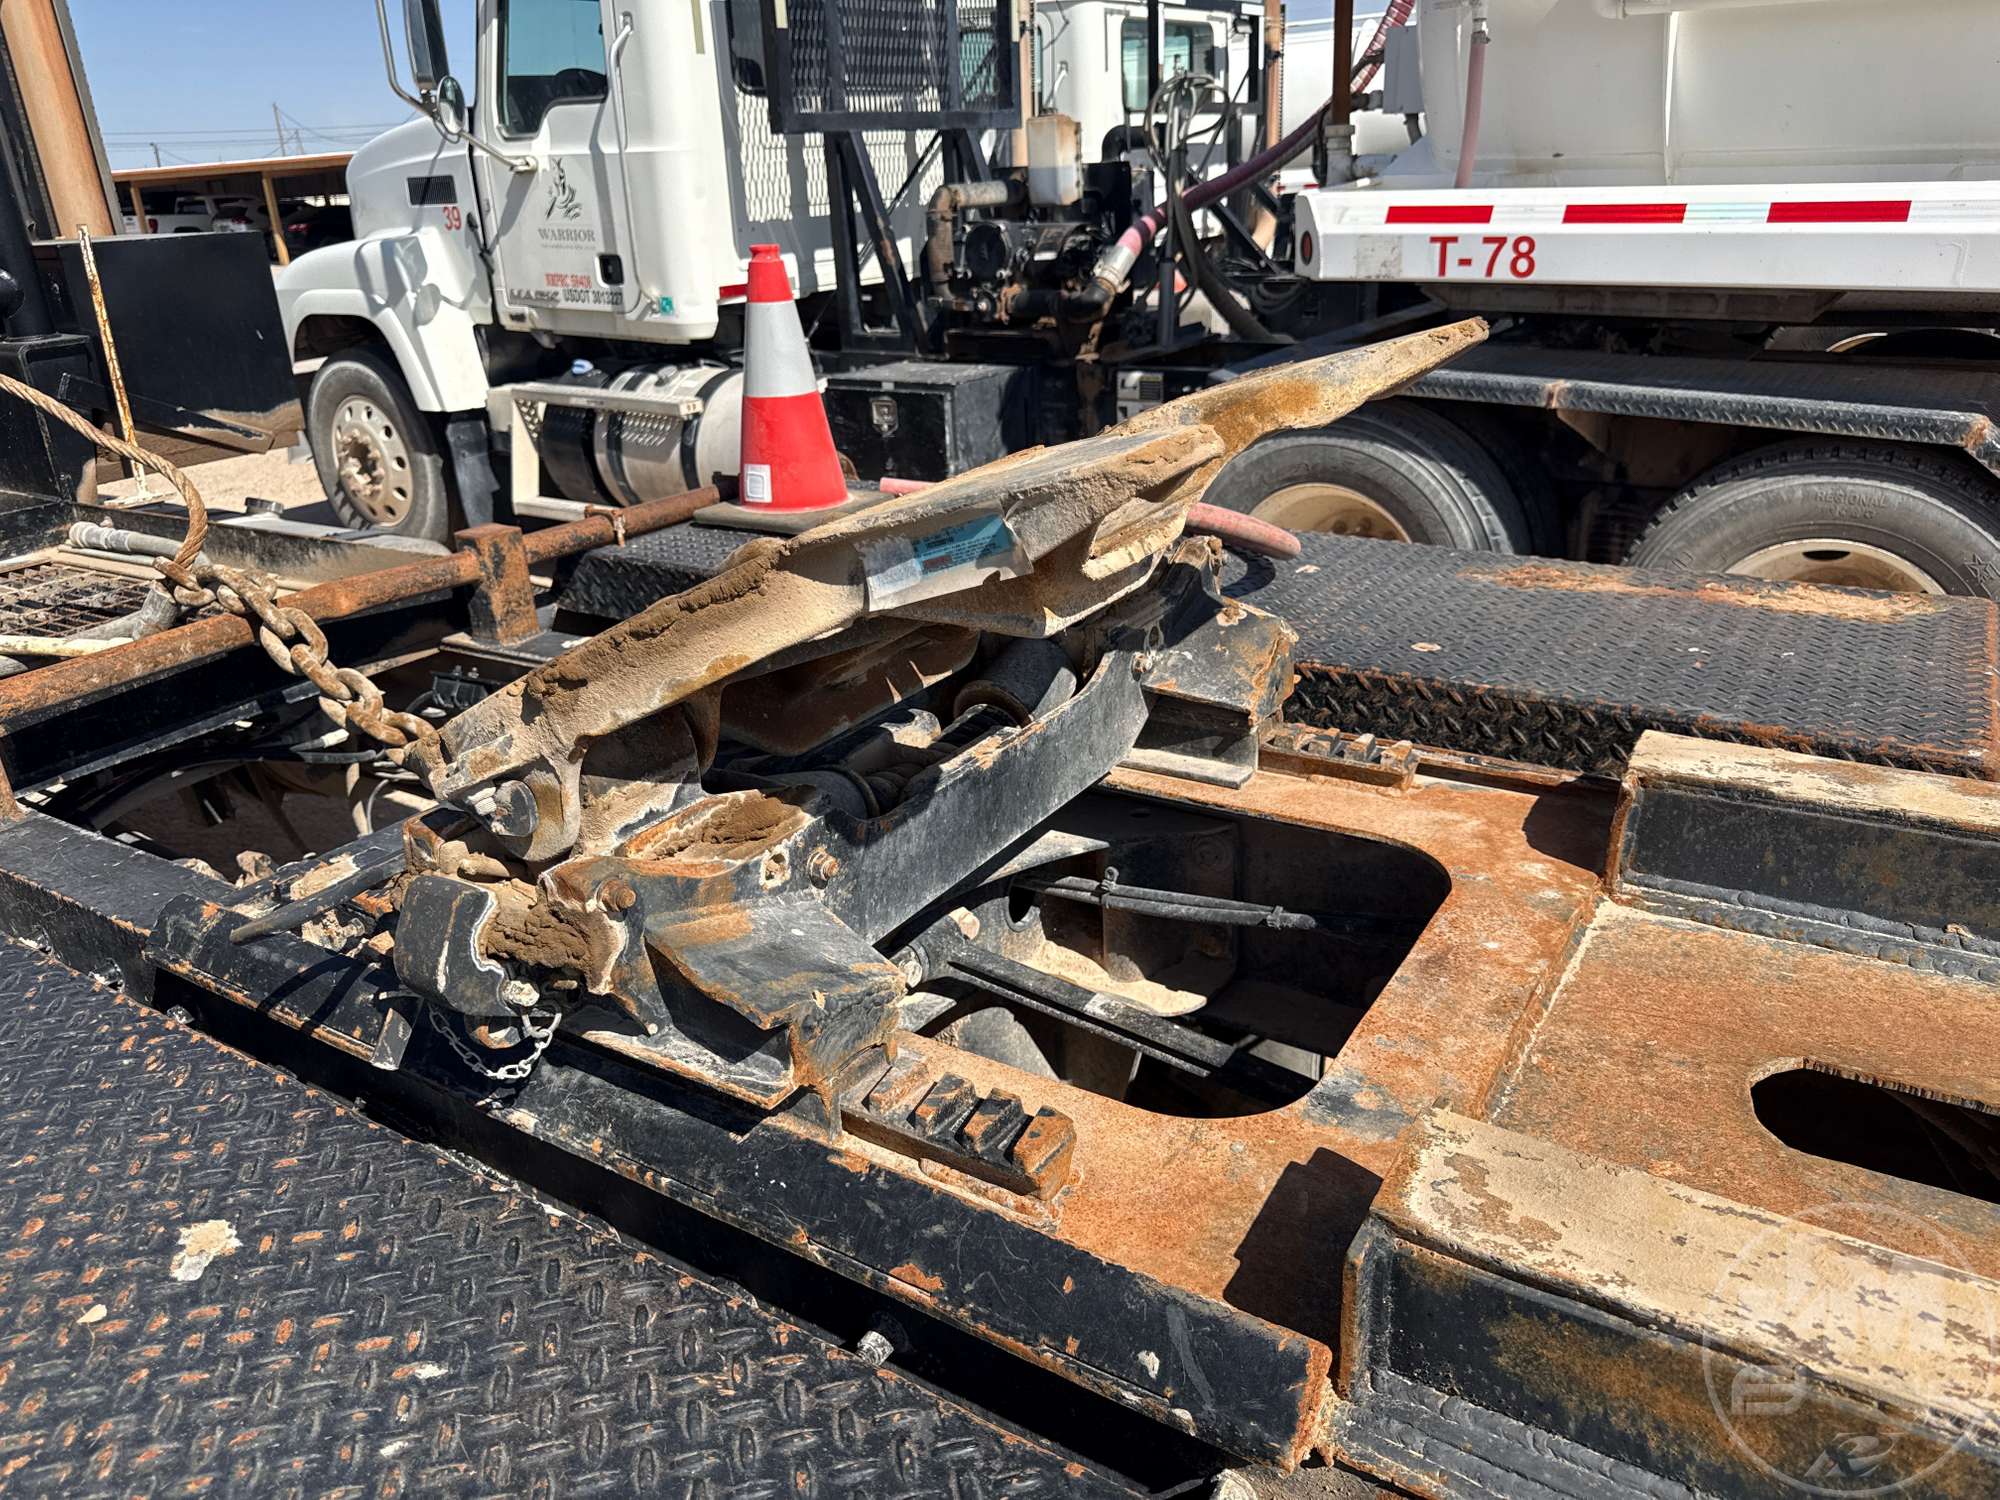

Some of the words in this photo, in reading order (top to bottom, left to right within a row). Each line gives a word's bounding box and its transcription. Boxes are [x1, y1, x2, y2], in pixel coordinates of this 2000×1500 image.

[443, 206, 462, 231] 39
[538, 228, 595, 242] WARRIOR
[1429, 236, 1536, 278] T-78
[1816, 490, 1888, 509] REGIONAL
